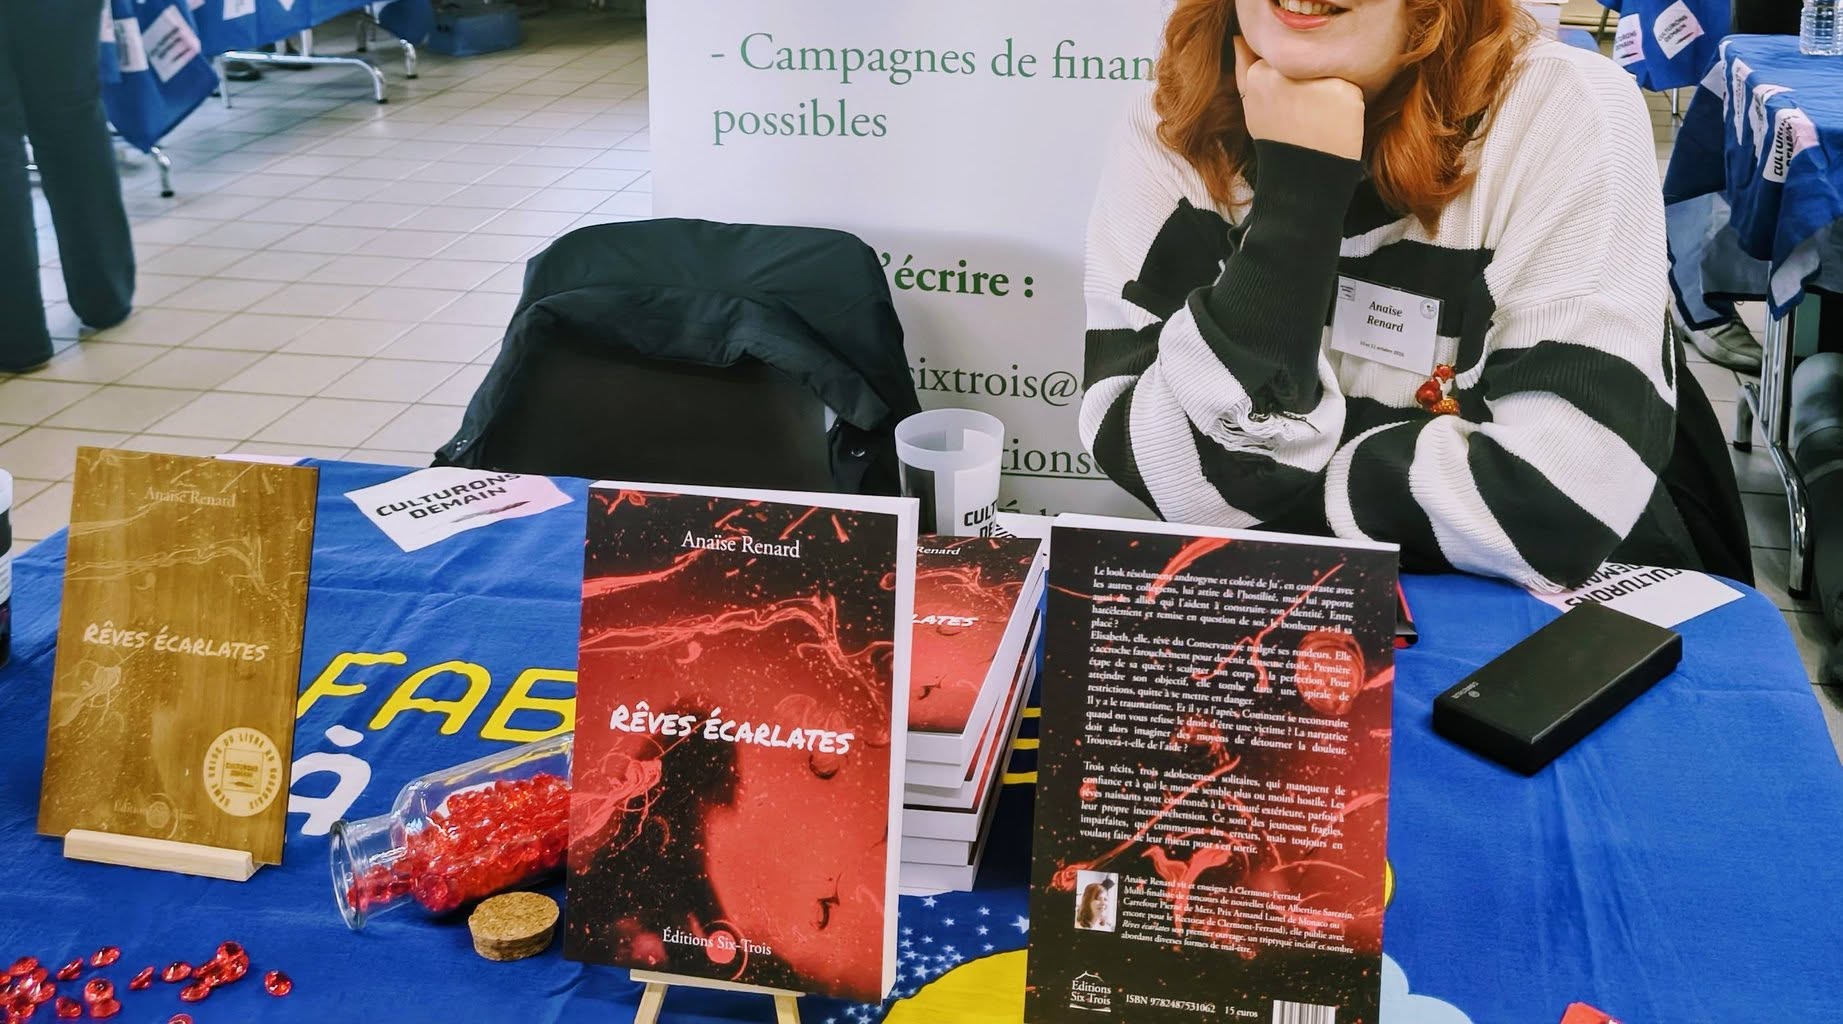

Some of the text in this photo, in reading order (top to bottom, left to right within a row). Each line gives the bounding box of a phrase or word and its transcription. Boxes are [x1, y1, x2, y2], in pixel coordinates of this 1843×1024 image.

[740, 32, 1156, 85] Campagnes de finan
[712, 98, 888, 145] possibles
[881, 252, 1010, 297] 'écrire
[1366, 314, 1404, 333] Renard
[1369, 301, 1403, 318] Anaïse
[908, 356, 1079, 407] ixtrois@
[190, 488, 237, 509] Renard
[376, 472, 521, 517] CULTURONS
[409, 486, 508, 519] DEMAIN
[963, 499, 998, 527] CULT
[681, 530, 801, 558] Anaïse Renard
[912, 614, 979, 627] LATES
[84, 620, 270, 663] RÊVES ÉCARLATES
[296, 651, 578, 744] FAB
[609, 700, 856, 755] RÊVES ÉCARLATES
[662, 926, 772, 955] Éditions Six-Trois
[1126, 994, 1149, 1005] ISBN
[1224, 1005, 1235, 1015] 15
[1236, 1008, 1259, 1018] euros
